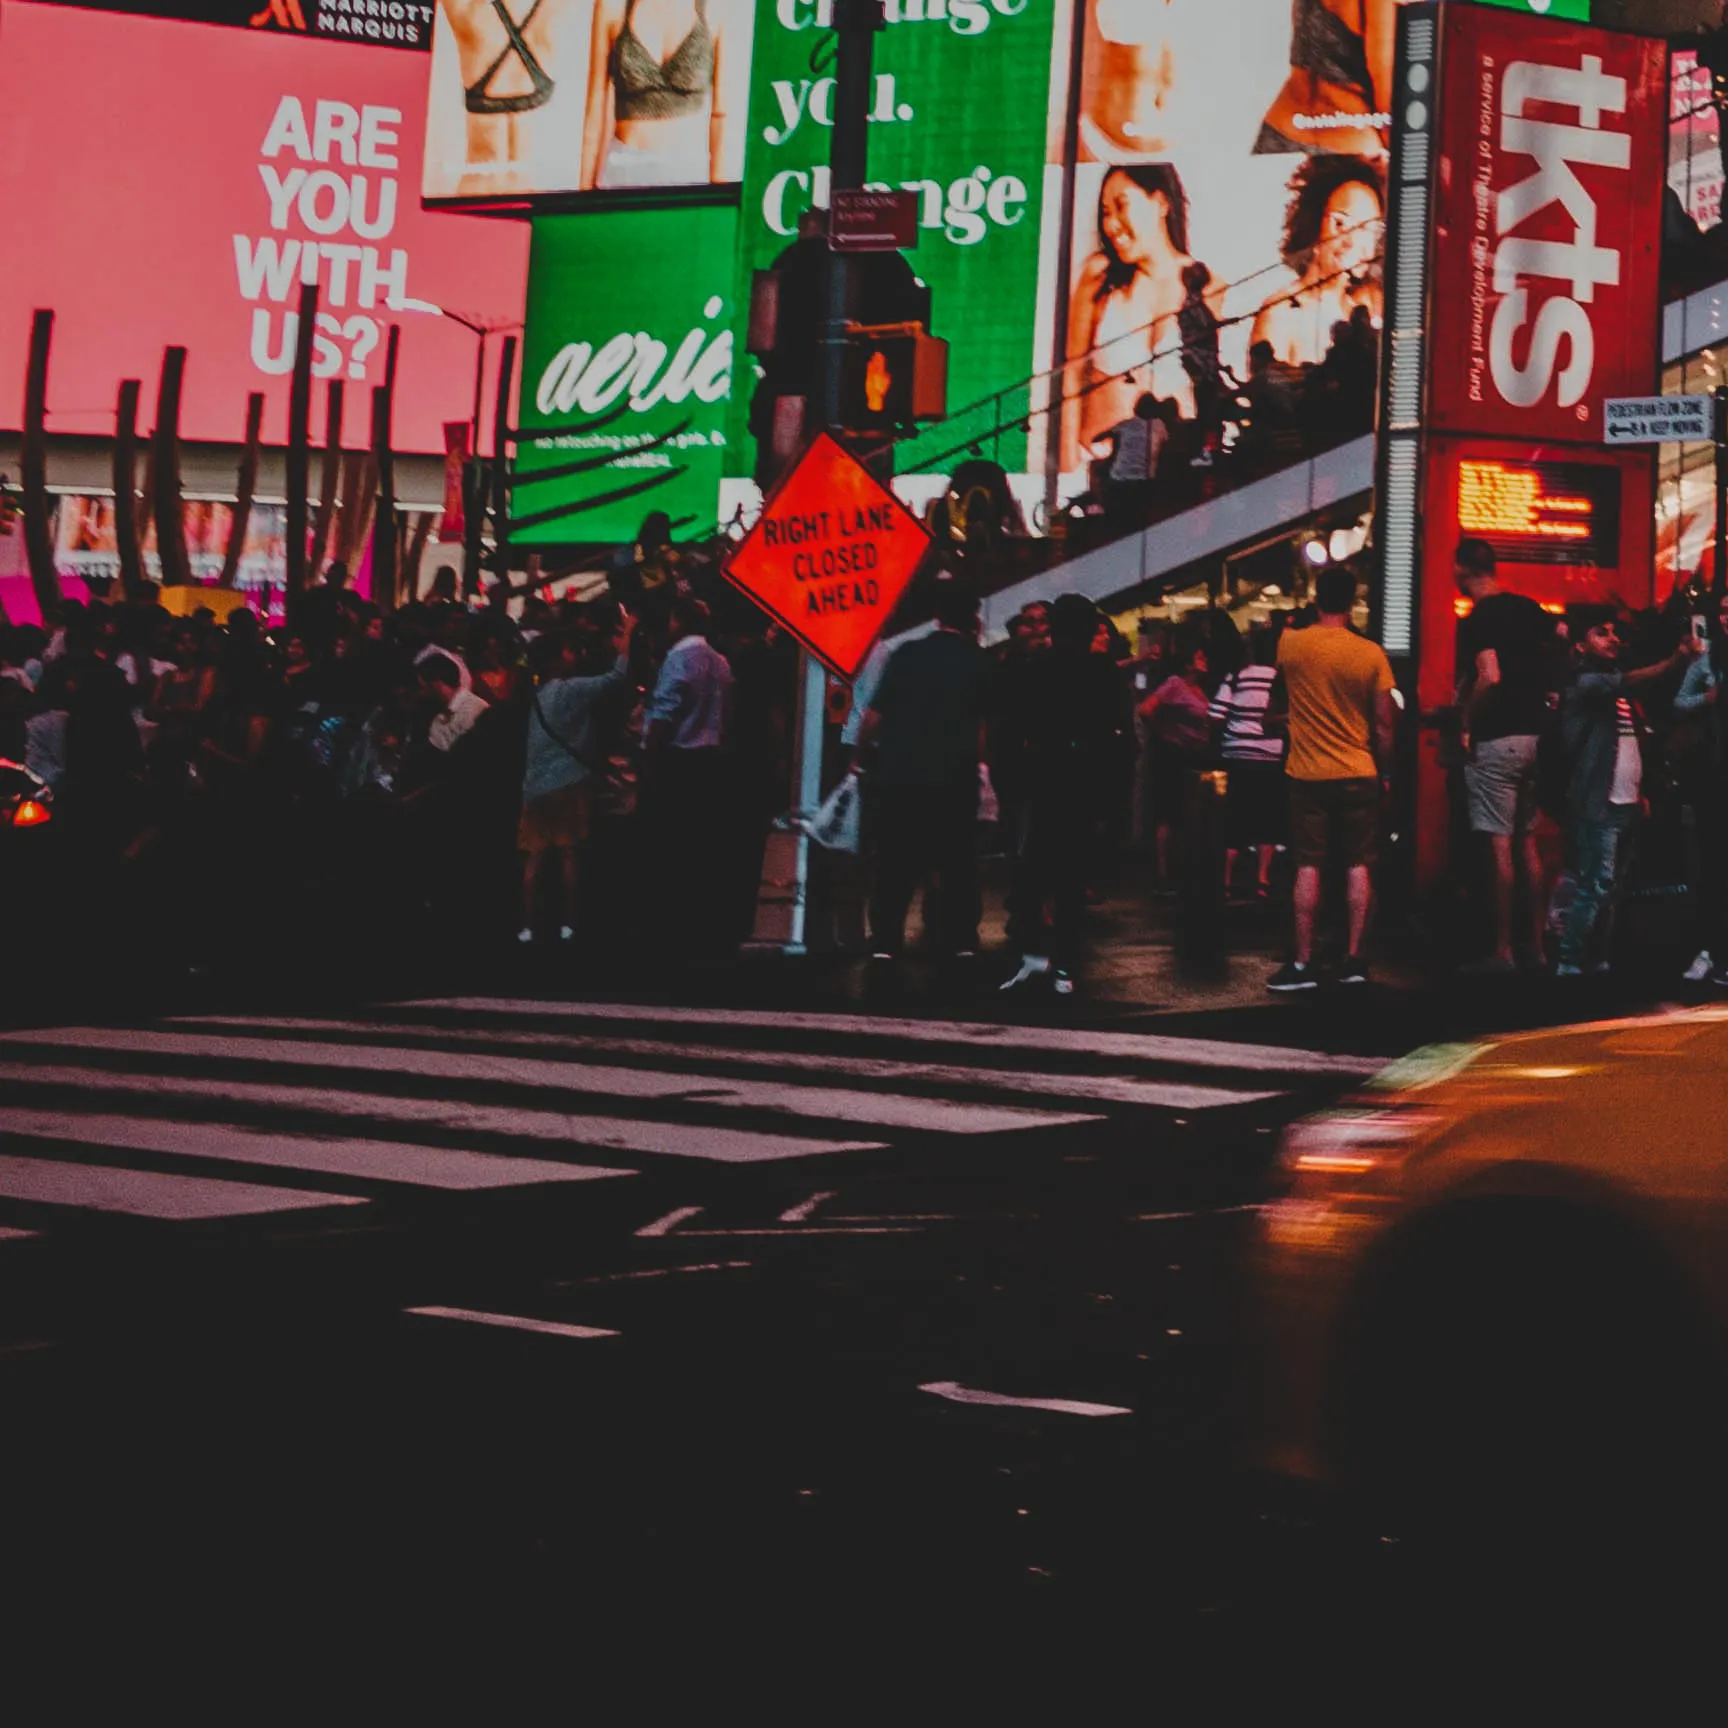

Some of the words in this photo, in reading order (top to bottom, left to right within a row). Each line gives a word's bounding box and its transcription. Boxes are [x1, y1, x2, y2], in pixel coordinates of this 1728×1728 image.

[317, 12, 419, 43] MARQUIS
[261, 95, 403, 169] ARE
[1480, 72, 1494, 136] service
[1479, 139, 1493, 158] of
[258, 164, 398, 240] YOU
[761, 165, 1027, 245] Cnge
[1475, 164, 1493, 230] Theatre
[1489, 53, 1631, 408] tkts
[233, 234, 408, 312] WITH
[1469, 235, 1490, 353] Development
[251, 309, 380, 379] US?
[1468, 356, 1484, 402] Fund
[764, 511, 829, 548] RIGHT
[840, 503, 897, 537] LANE
[793, 542, 878, 582] CLOSED
[806, 579, 879, 615] AHEAD
